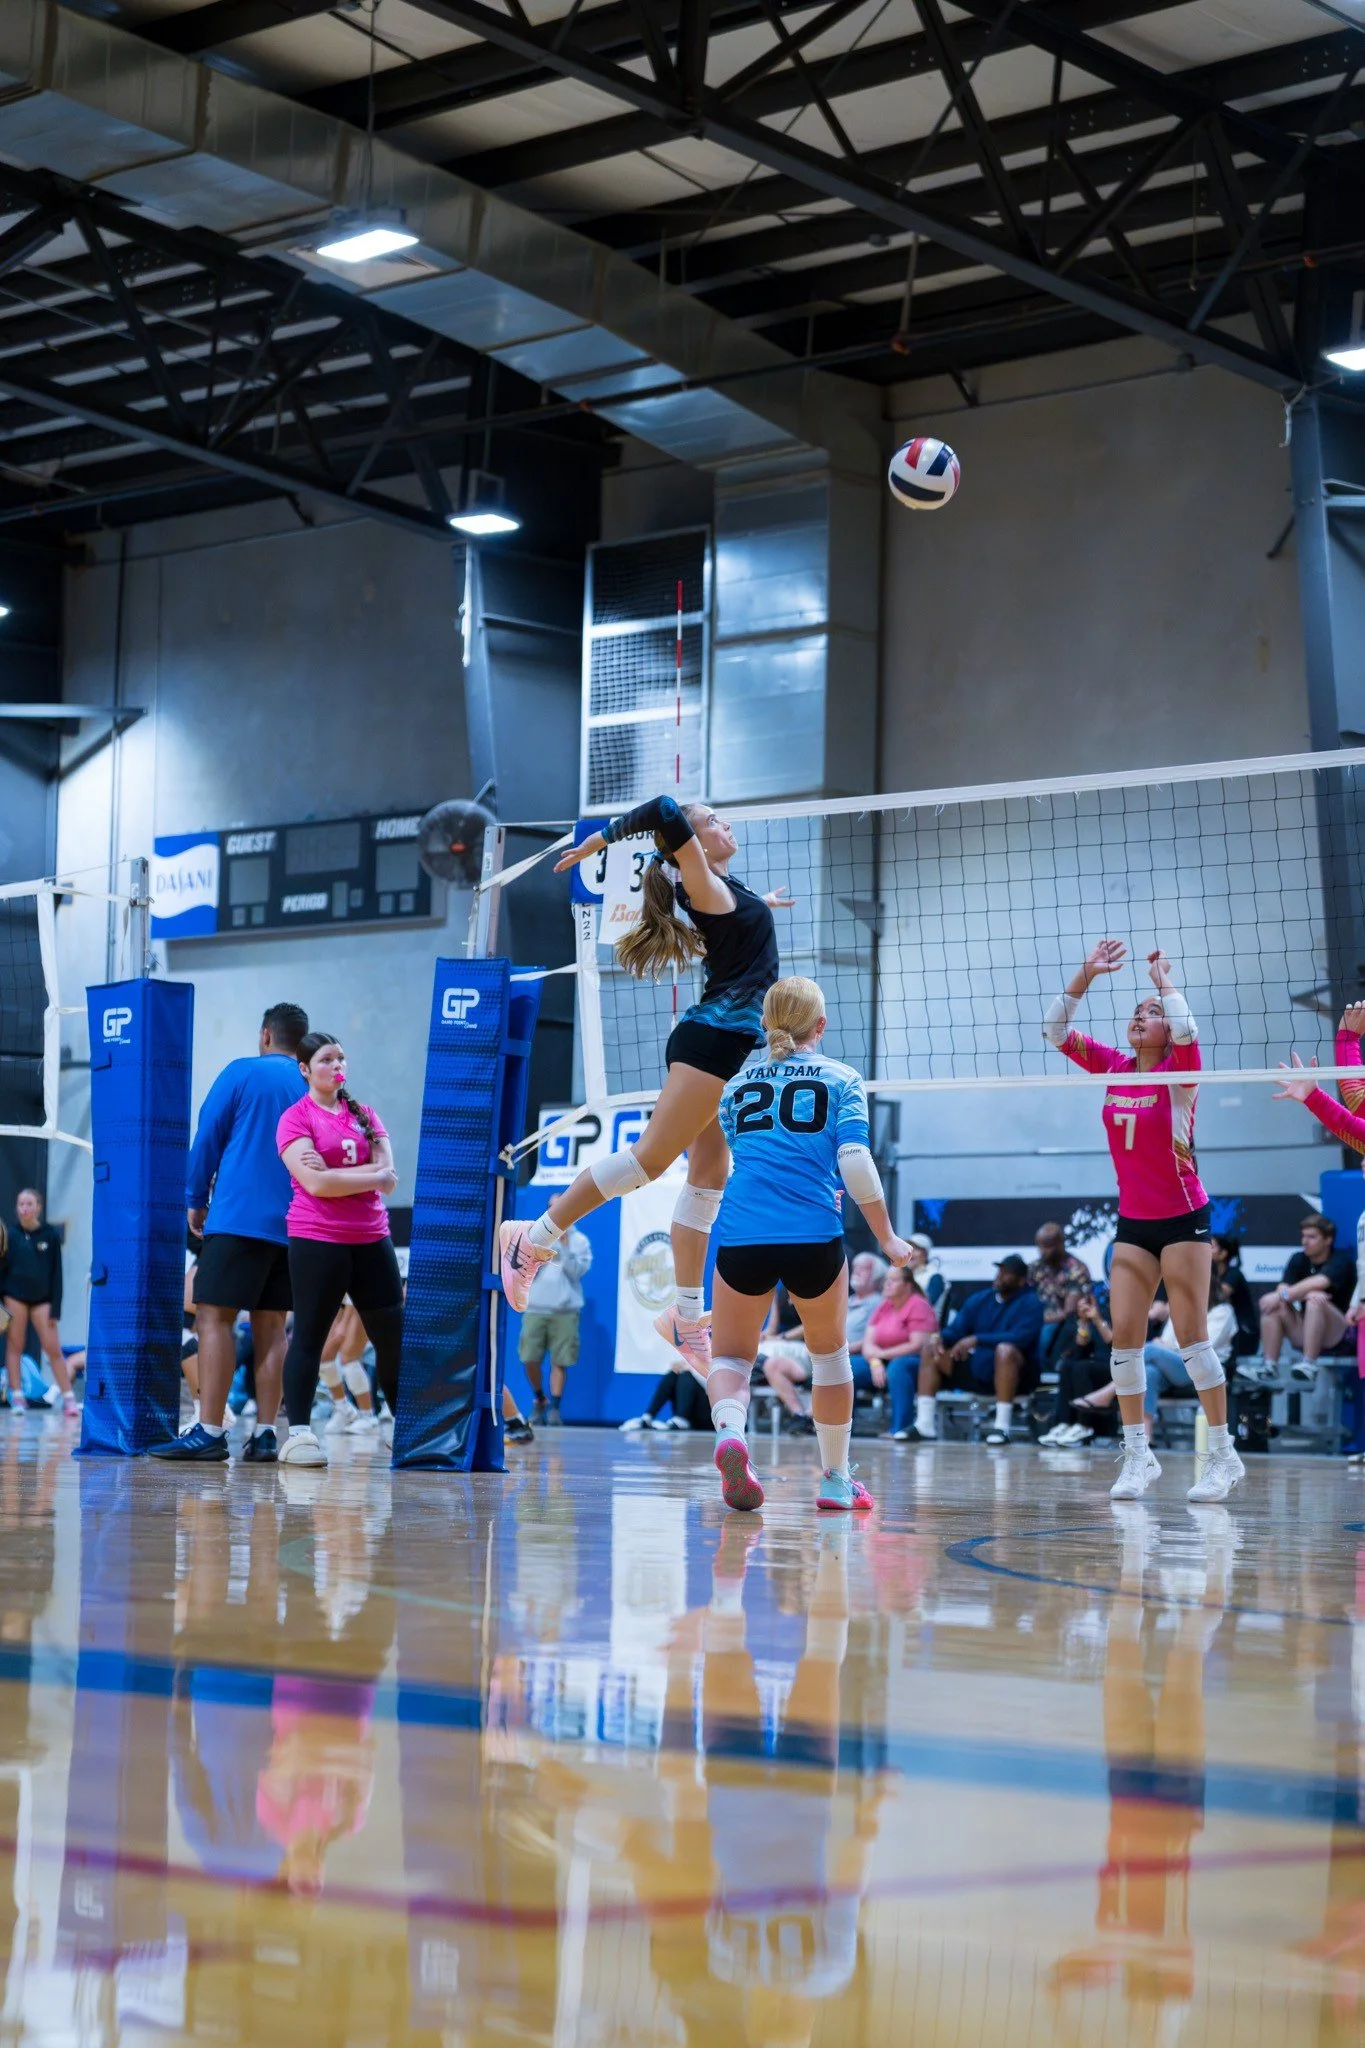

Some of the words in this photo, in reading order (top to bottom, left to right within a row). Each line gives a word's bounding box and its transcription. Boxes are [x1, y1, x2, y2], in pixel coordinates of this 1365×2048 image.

[226, 831, 277, 855] GUEST
[156, 868, 214, 894] DASANI
[282, 892, 328, 913] PERIOD
[442, 988, 480, 1019] GP
[103, 1007, 132, 1037] GP
[746, 1067, 778, 1080] VAN
[784, 1066, 821, 1077] DAM
[733, 1080, 829, 1136] 20
[540, 1114, 601, 1167] GP
[1113, 1112, 1137, 1151] 7
[341, 1139, 357, 1165] 3
